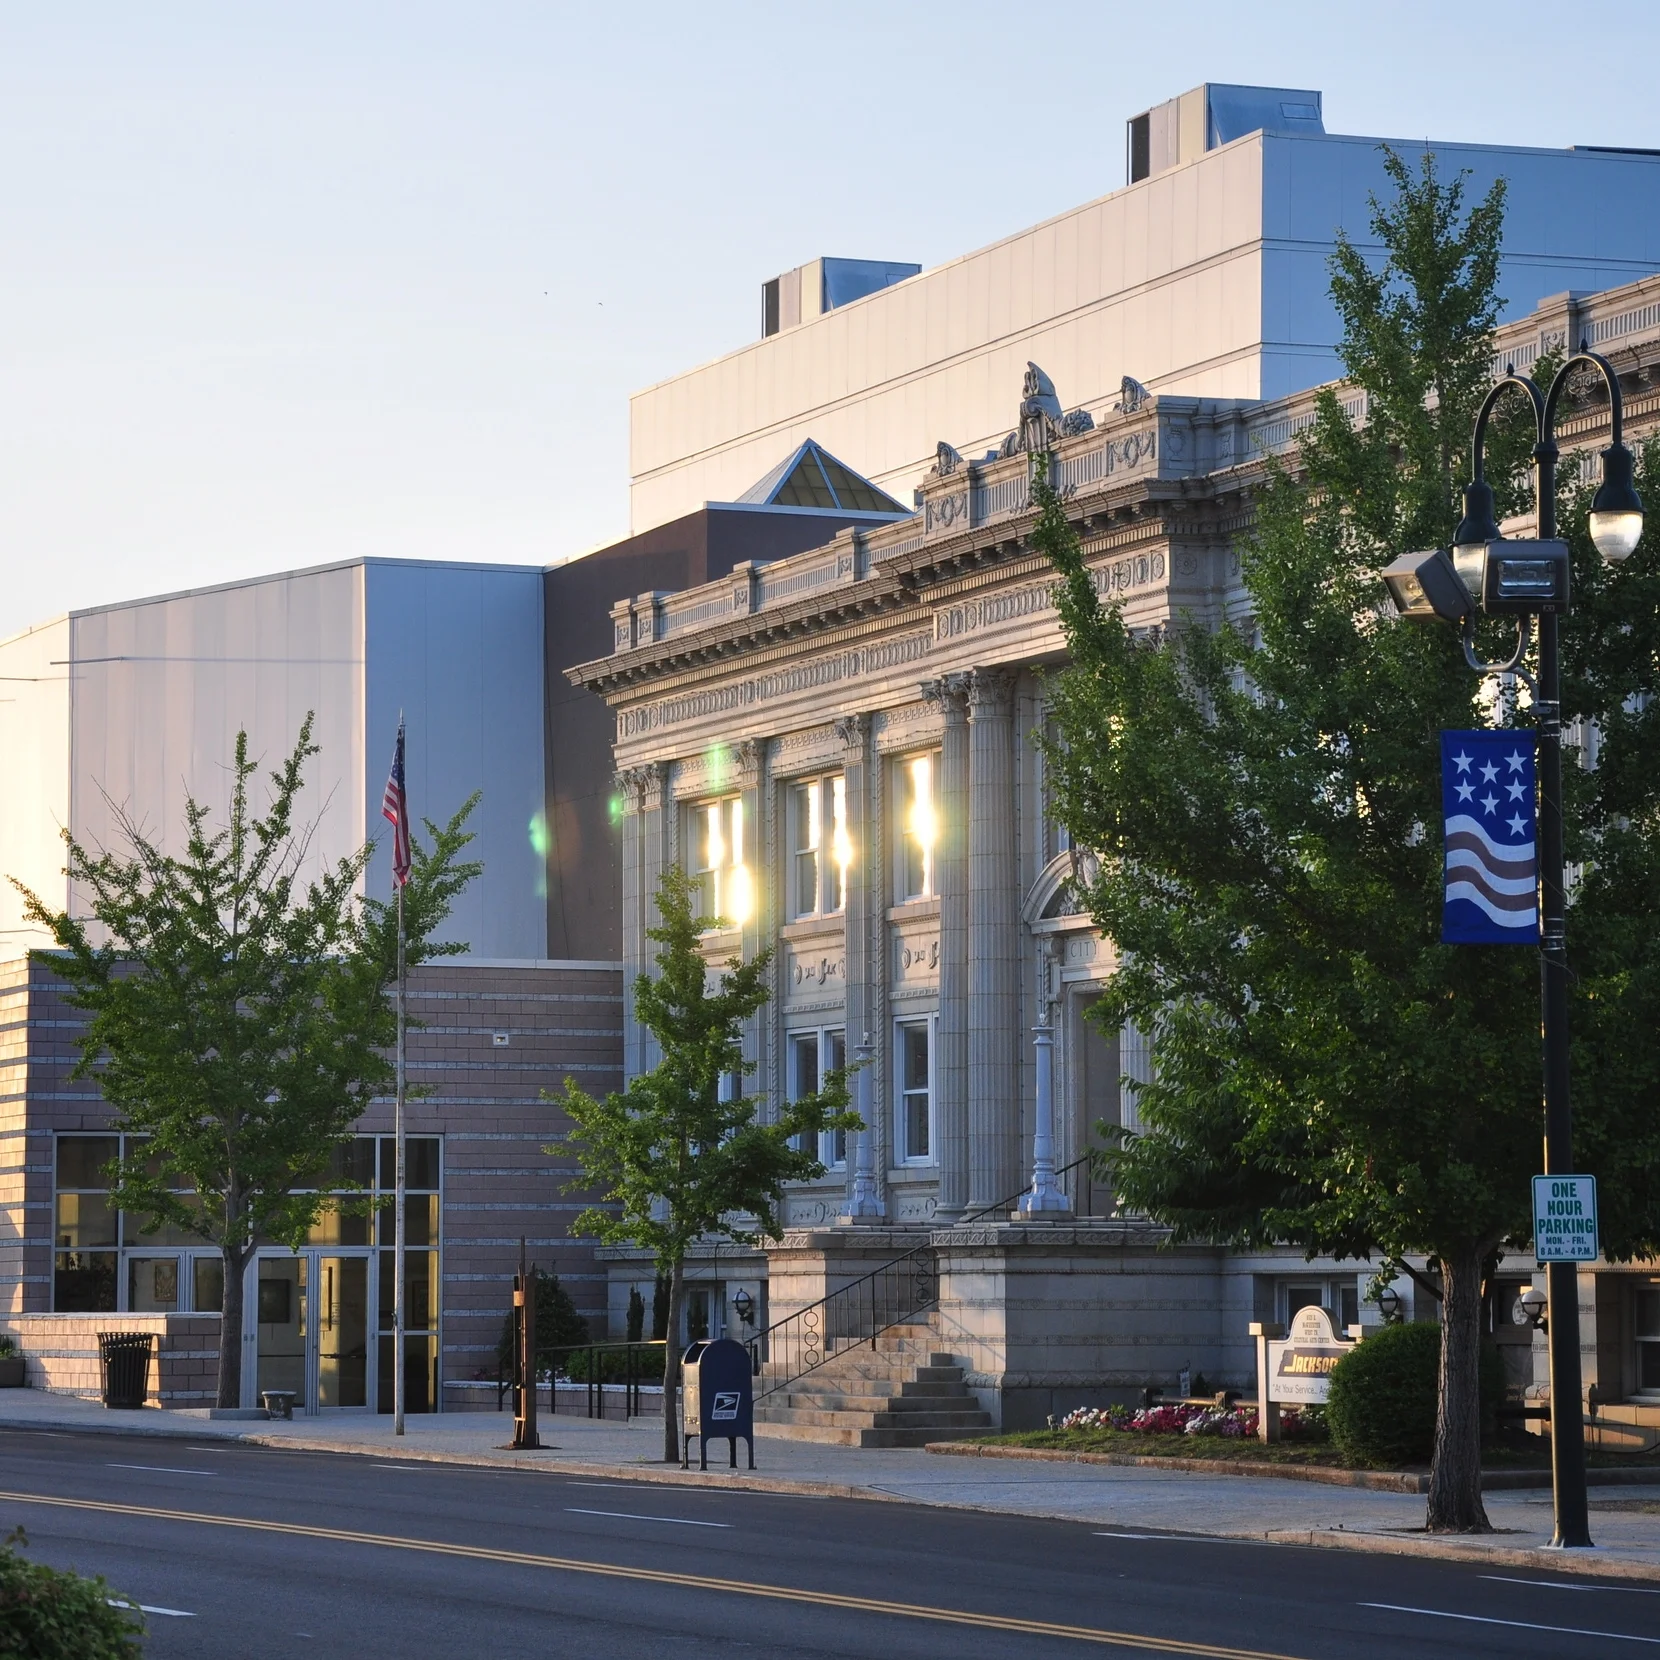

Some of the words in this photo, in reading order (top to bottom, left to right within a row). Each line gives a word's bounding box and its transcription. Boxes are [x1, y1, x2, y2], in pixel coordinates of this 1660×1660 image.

[1070, 941, 1098, 958] CITY
[1552, 1182, 1577, 1198] ONE
[1547, 1200, 1583, 1216] HOUR
[1538, 1218, 1593, 1234] PARKING
[1546, 1236, 1565, 1245] MON.
[1572, 1236, 1587, 1245] FRI.
[1540, 1247, 1546, 1256] 8
[1547, 1247, 1564, 1256] A.M.
[1570, 1247, 1576, 1256] 4
[1577, 1247, 1593, 1256] P.M.
[1282, 1384, 1293, 1394] Your
